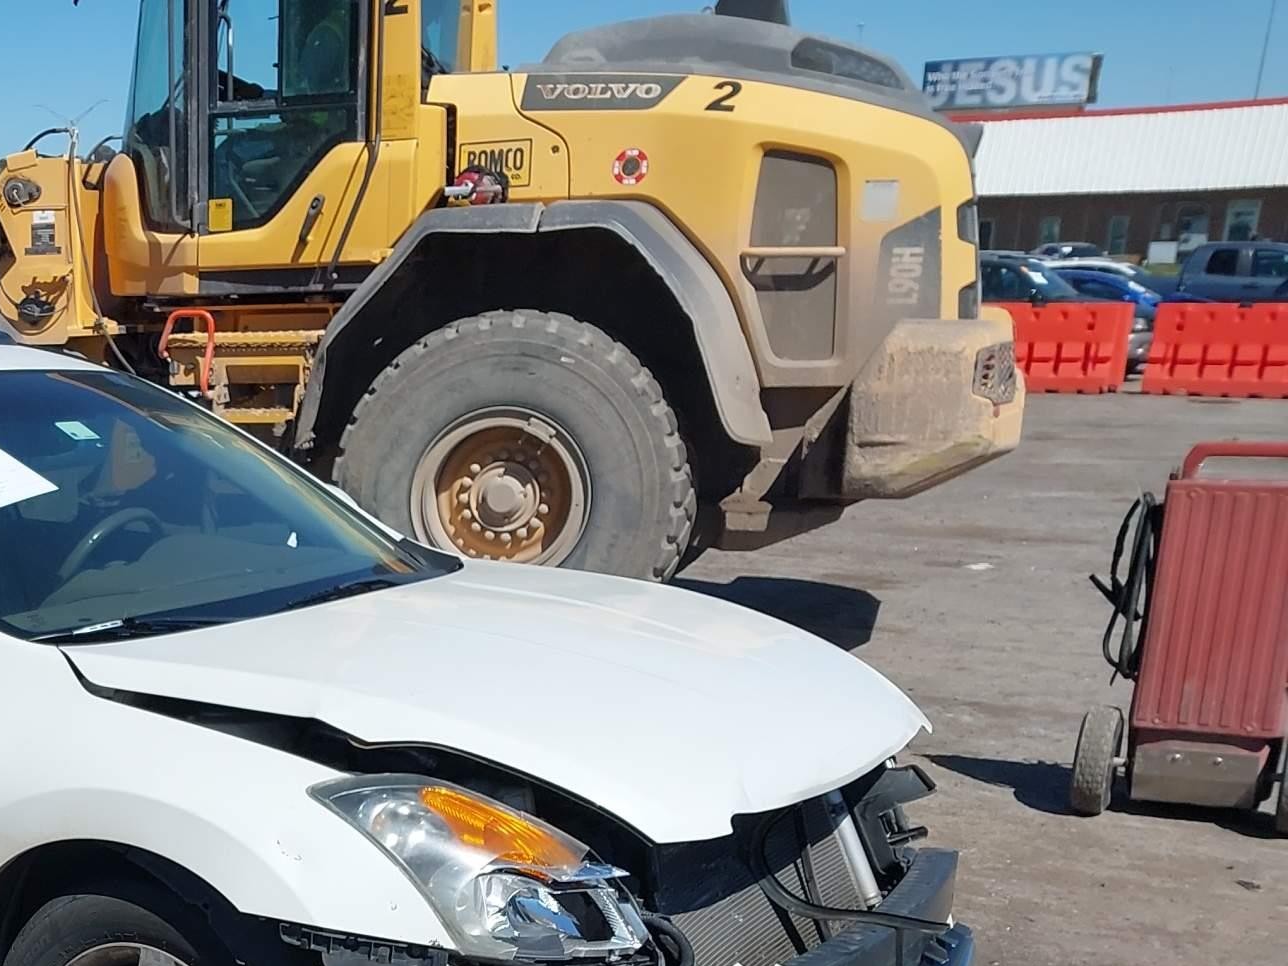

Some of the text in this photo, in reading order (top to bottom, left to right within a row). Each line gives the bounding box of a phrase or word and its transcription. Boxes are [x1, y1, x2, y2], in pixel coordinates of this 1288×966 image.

[536, 84, 661, 99] VOLVO
[704, 81, 742, 112] 2
[925, 55, 1091, 105] JESUS
[886, 246, 925, 304] L90H
